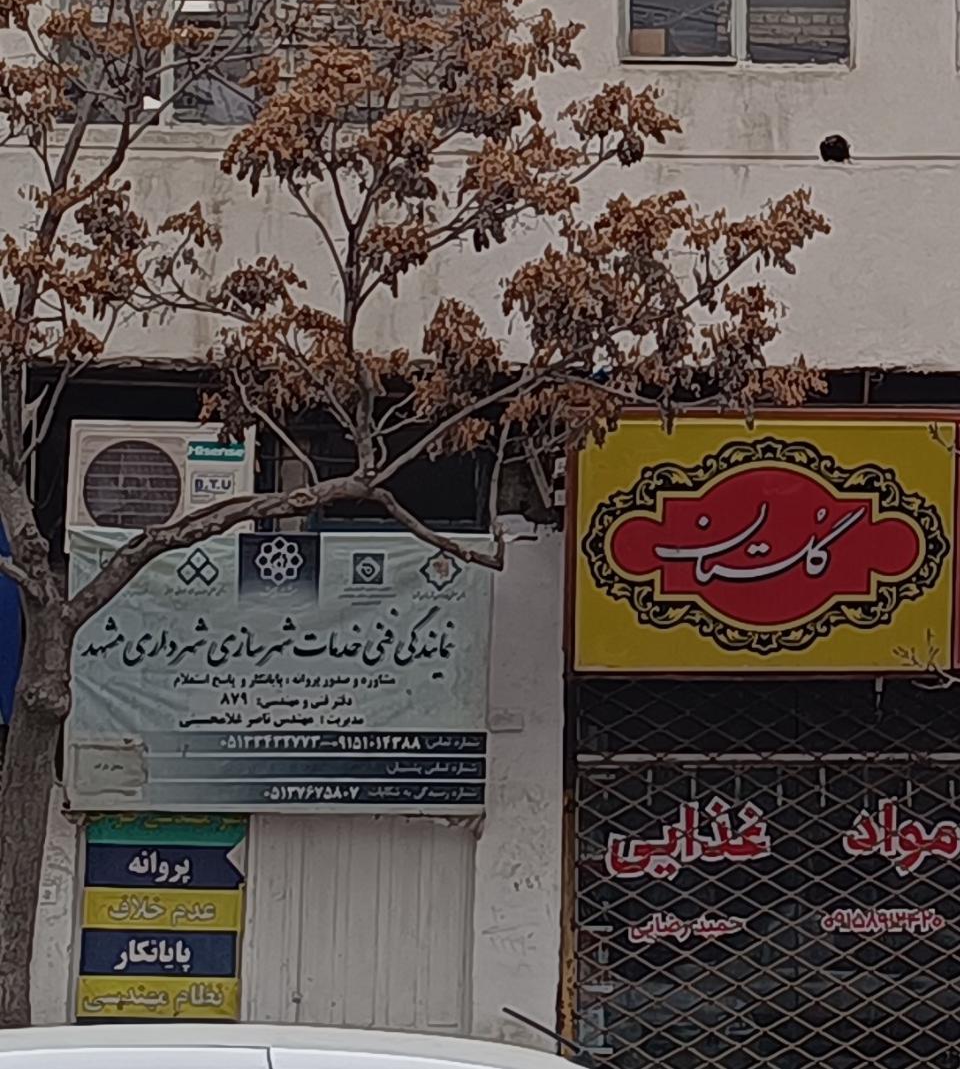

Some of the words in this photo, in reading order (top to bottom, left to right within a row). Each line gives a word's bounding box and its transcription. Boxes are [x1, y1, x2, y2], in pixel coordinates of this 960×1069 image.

[654, 501, 866, 583] گلستان
[81, 616, 125, 659] مشهد
[122, 617, 209, 667] شهرداری
[206, 617, 297, 667] شهرسازی
[293, 623, 363, 659] خدمات
[362, 608, 398, 667] فنی
[394, 605, 456, 680] نمایندگی
[219, 693, 249, 706] ۸۷۹
[605, 795, 772, 881] غذایی
[128, 849, 192, 884] پروانه
[107, 894, 167, 922] خلاف
[171, 902, 217, 926] عدم
[113, 939, 192, 973] پایانکار
[83, 984, 169, 1013] مهندسی
[174, 982, 225, 1015] نظام
